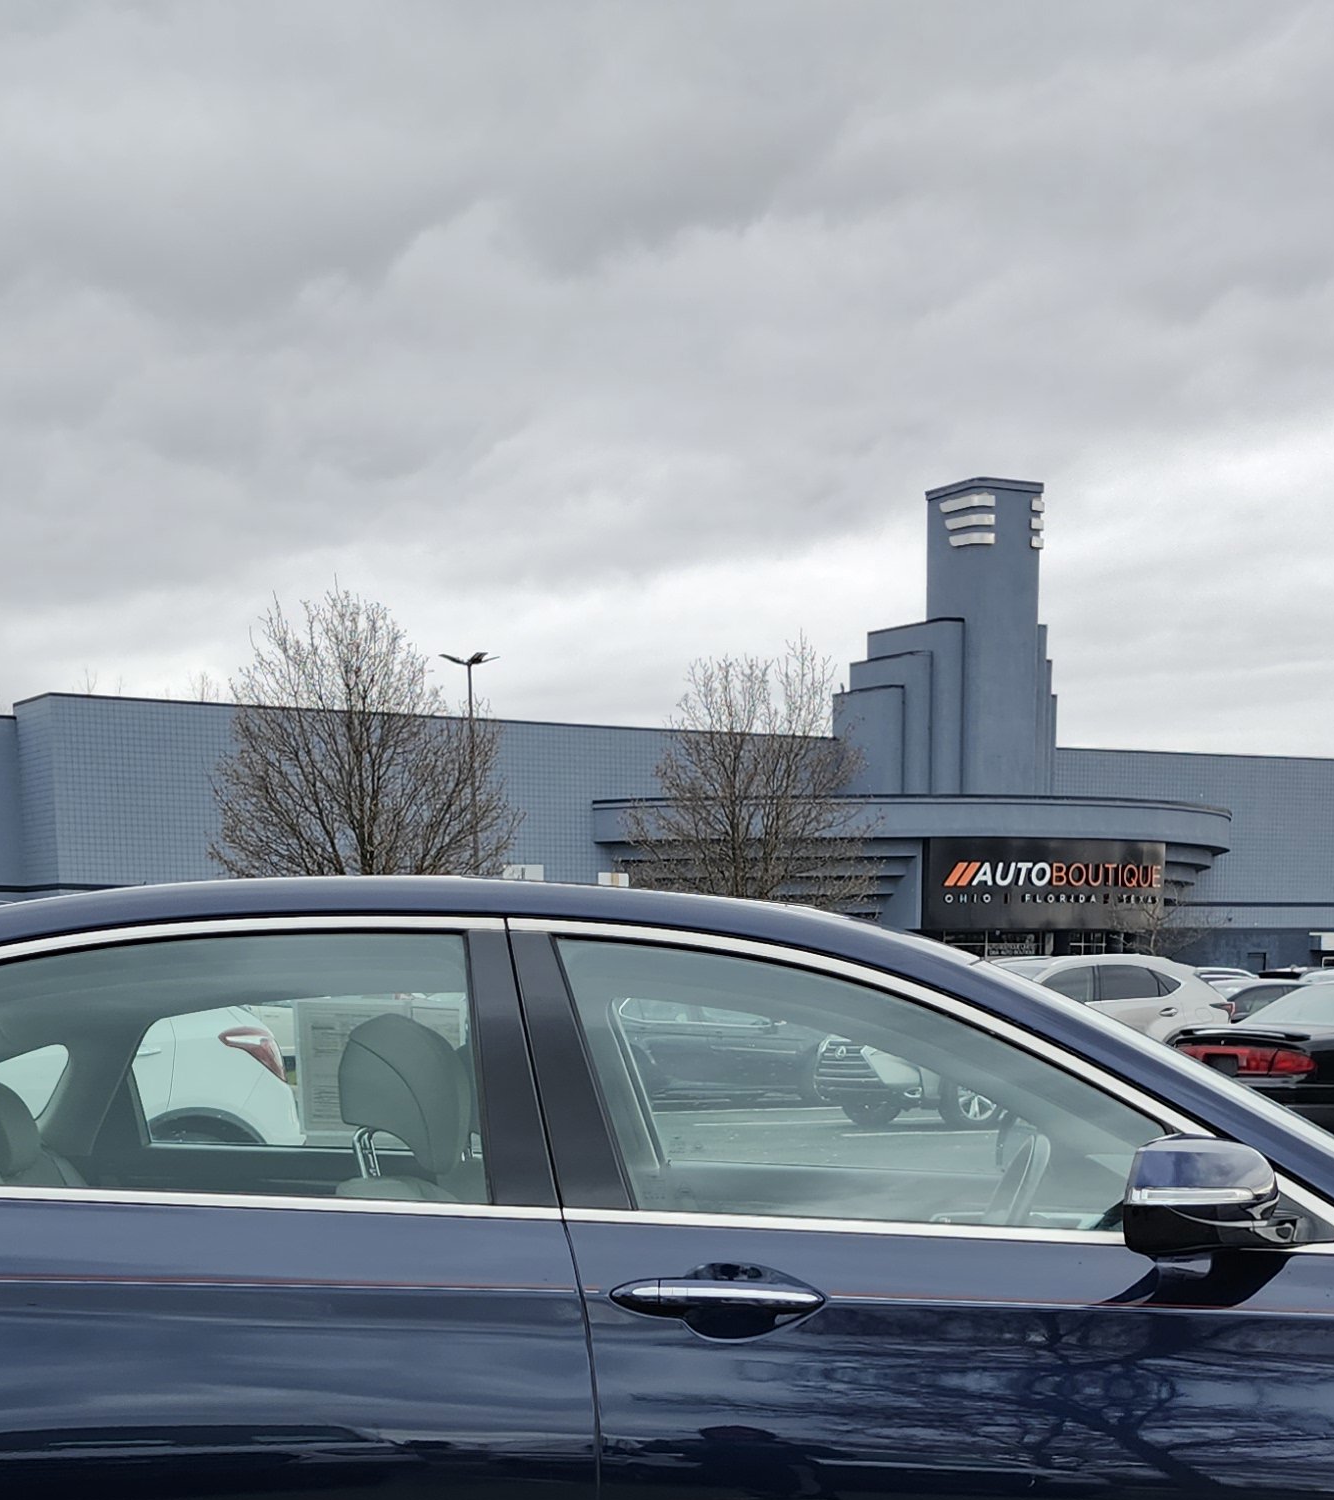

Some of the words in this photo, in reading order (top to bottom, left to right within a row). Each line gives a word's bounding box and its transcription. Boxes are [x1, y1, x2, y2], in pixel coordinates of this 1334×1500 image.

[972, 861, 1162, 888] AUTOBOUTIQUE
[944, 893, 992, 904] OHIO
[1025, 893, 1097, 904] FLORIDA
